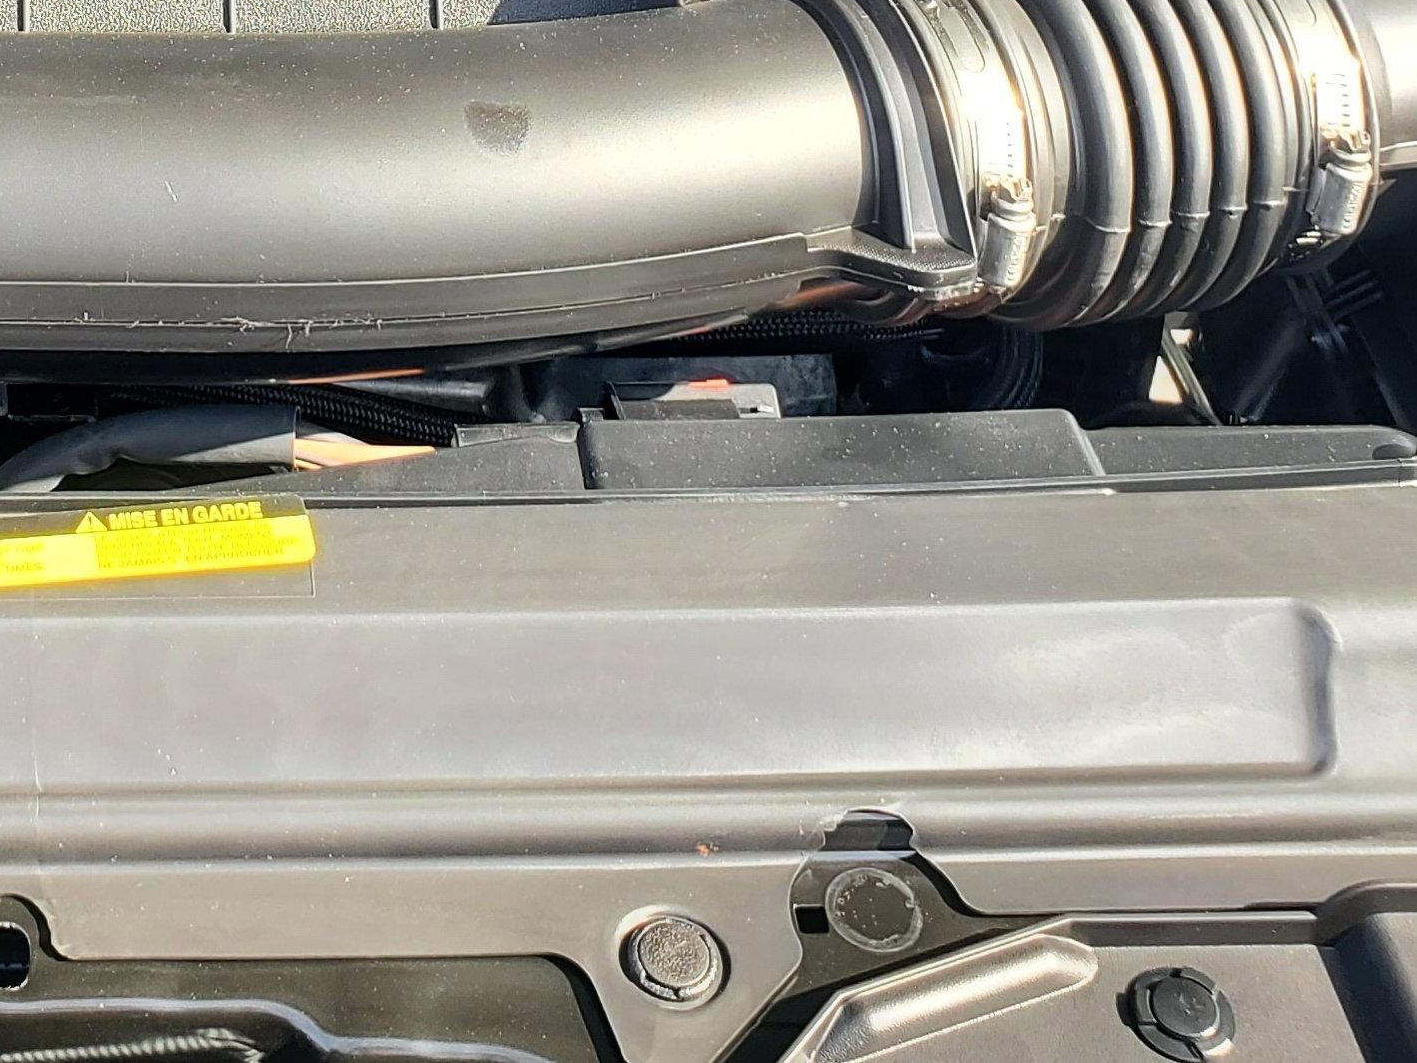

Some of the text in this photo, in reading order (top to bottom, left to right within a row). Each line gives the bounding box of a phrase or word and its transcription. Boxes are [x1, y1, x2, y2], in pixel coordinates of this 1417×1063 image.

[108, 501, 263, 530] MISE EN GARDE
